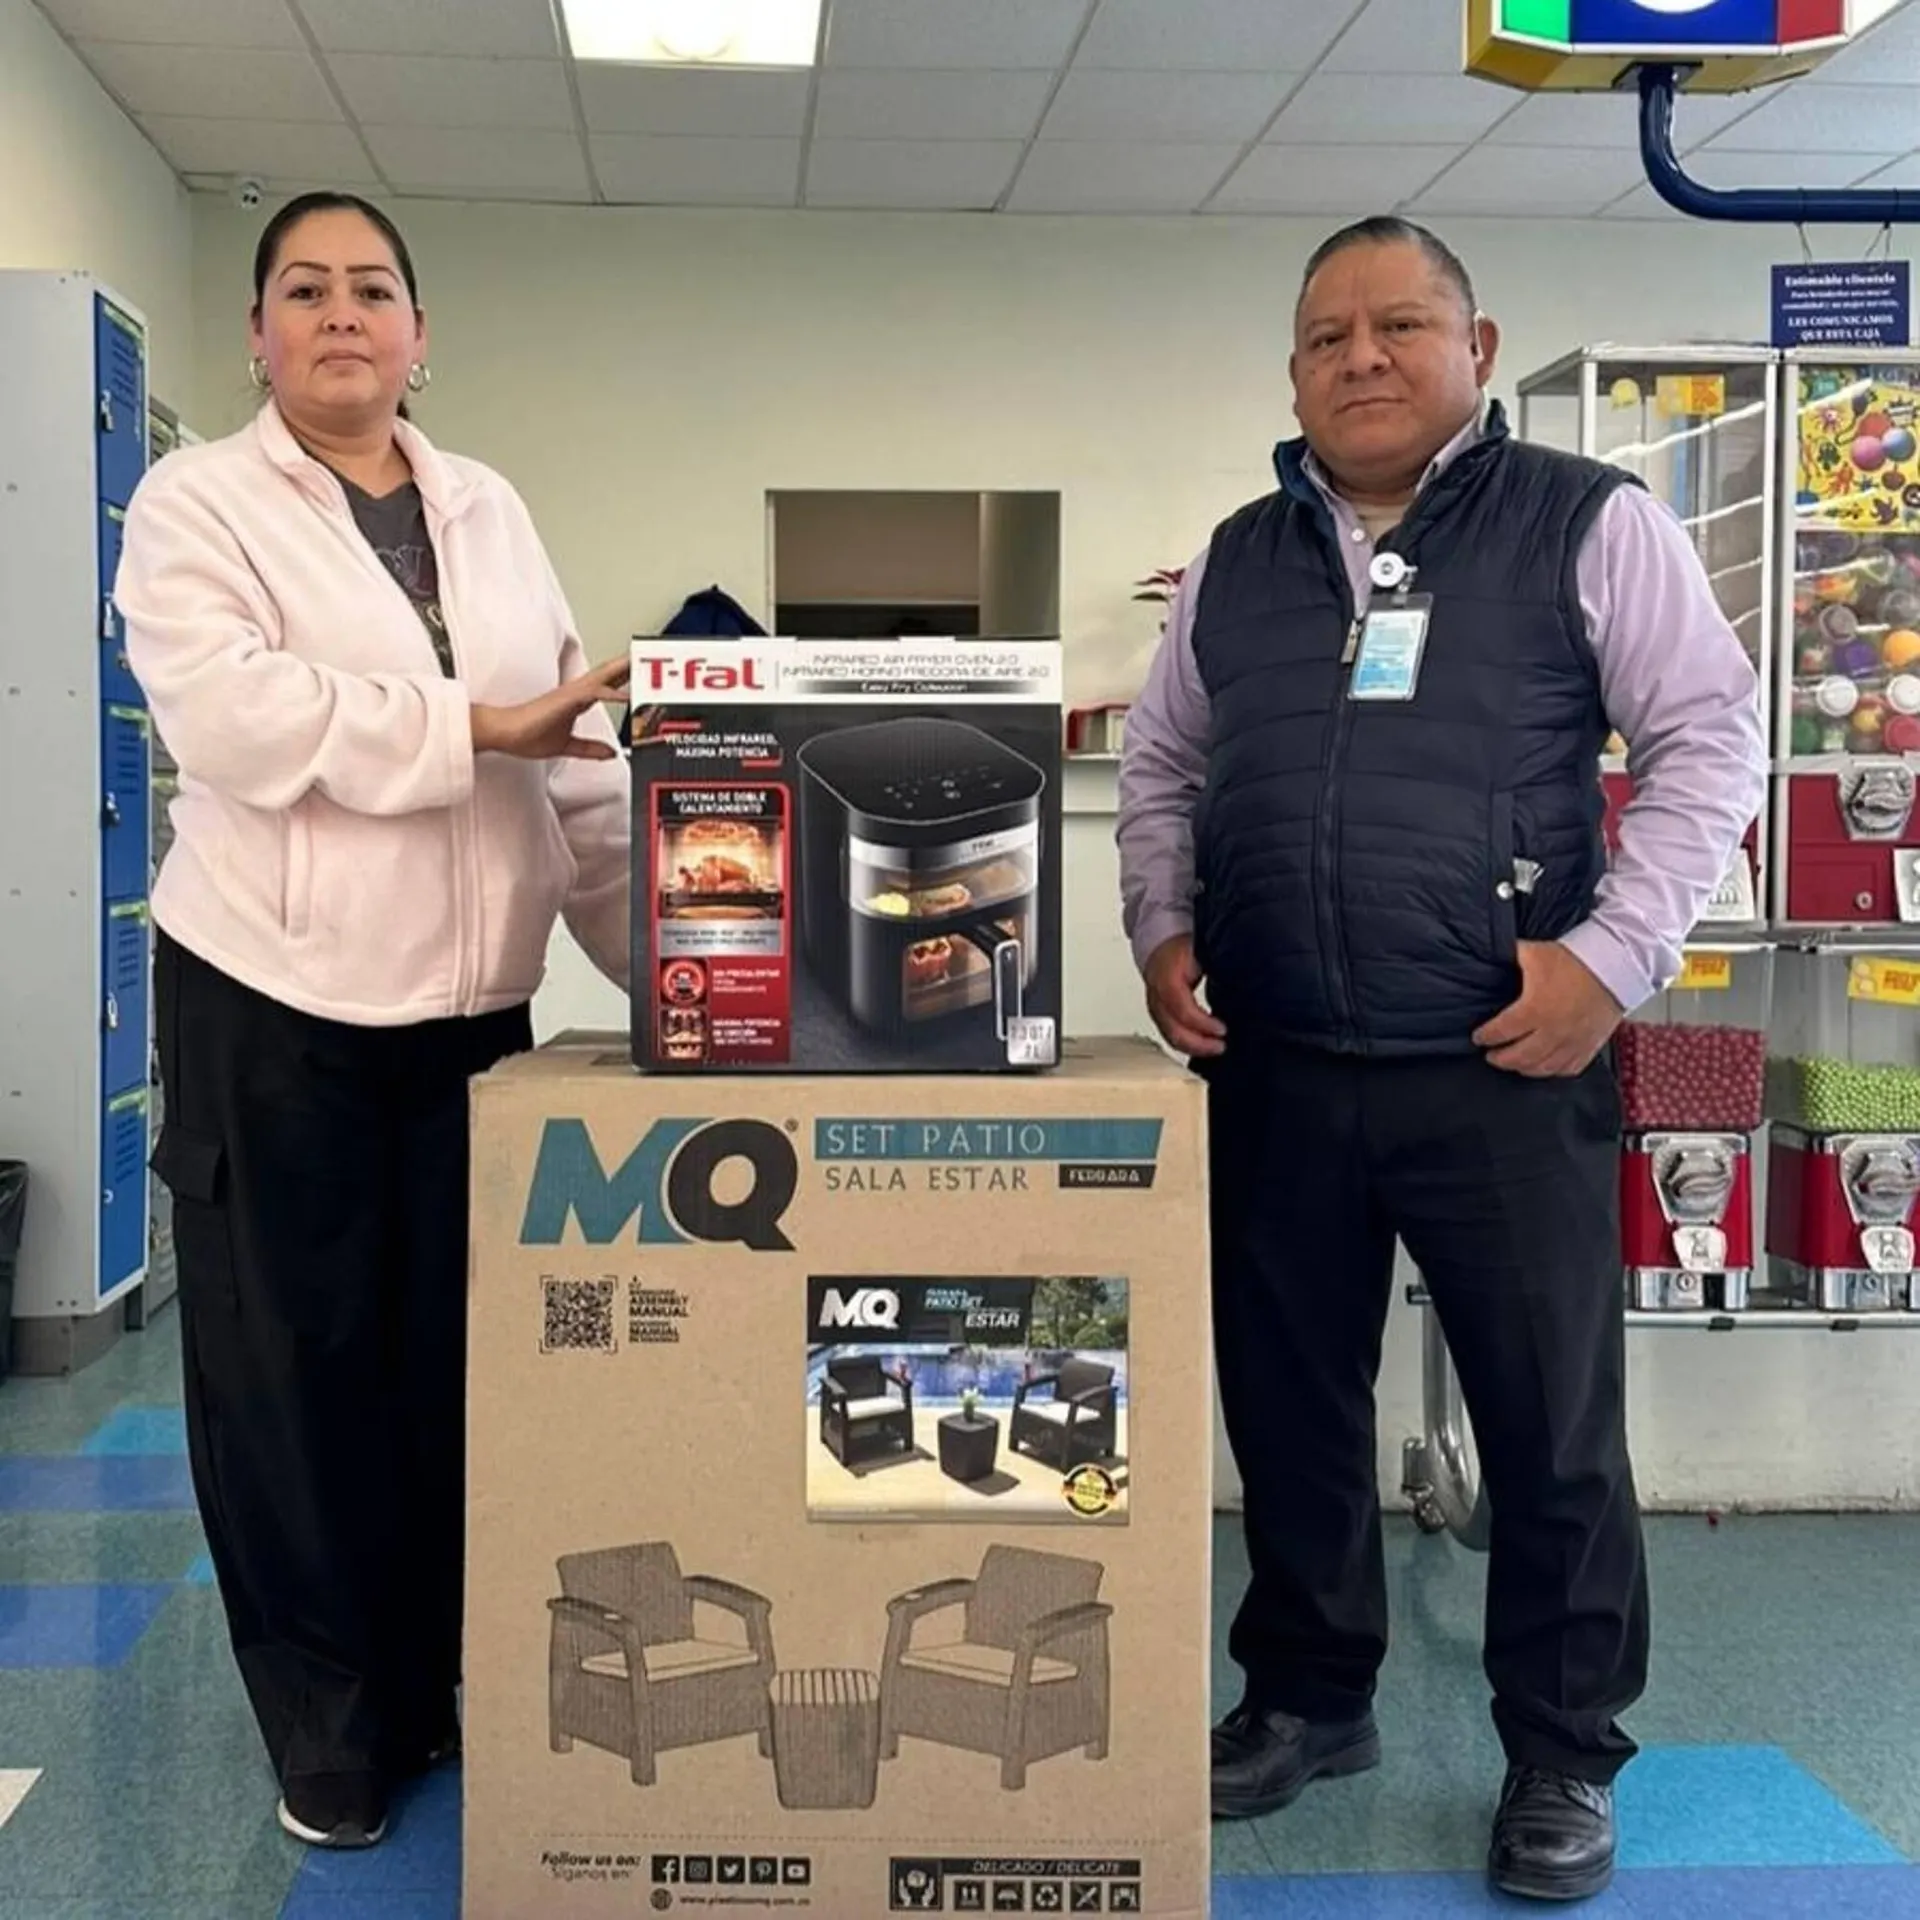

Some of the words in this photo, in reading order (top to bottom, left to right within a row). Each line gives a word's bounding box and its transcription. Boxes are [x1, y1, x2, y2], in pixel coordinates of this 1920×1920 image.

[1784, 274, 1843, 287] Estimable
[1845, 272, 1897, 285] clientela
[1788, 316, 1808, 327] LES
[1810, 314, 1894, 326] COMUNICAMOS
[1800, 329, 1823, 341] QUE
[1825, 328, 1852, 340] ESTA
[1854, 327, 1880, 339] CAJA
[665, 734, 720, 745] VELOCIDAD
[718, 747, 769, 757] POTENCIA
[672, 792, 715, 803] SISTEMA
[717, 792, 731, 802] DE
[733, 792, 767, 802] DOBLE
[679, 804, 762, 815] CALENTAMIENTO
[826, 1124, 896, 1154] SET
[923, 1124, 1047, 1154] PATIO
[519, 1117, 798, 1251] MQ
[826, 1166, 907, 1191] SALA
[928, 1166, 1030, 1191] ESTAR
[818, 1287, 901, 1329] MQ
[924, 1296, 959, 1308] PATIO
[629, 1306, 690, 1317] MANUAL
[965, 1312, 1021, 1328] ESTAR
[541, 1851, 592, 1866] Follow
[595, 1855, 612, 1866] us
[973, 1860, 1045, 1873] DELICADO
[1057, 1861, 1121, 1874] DELICATE
